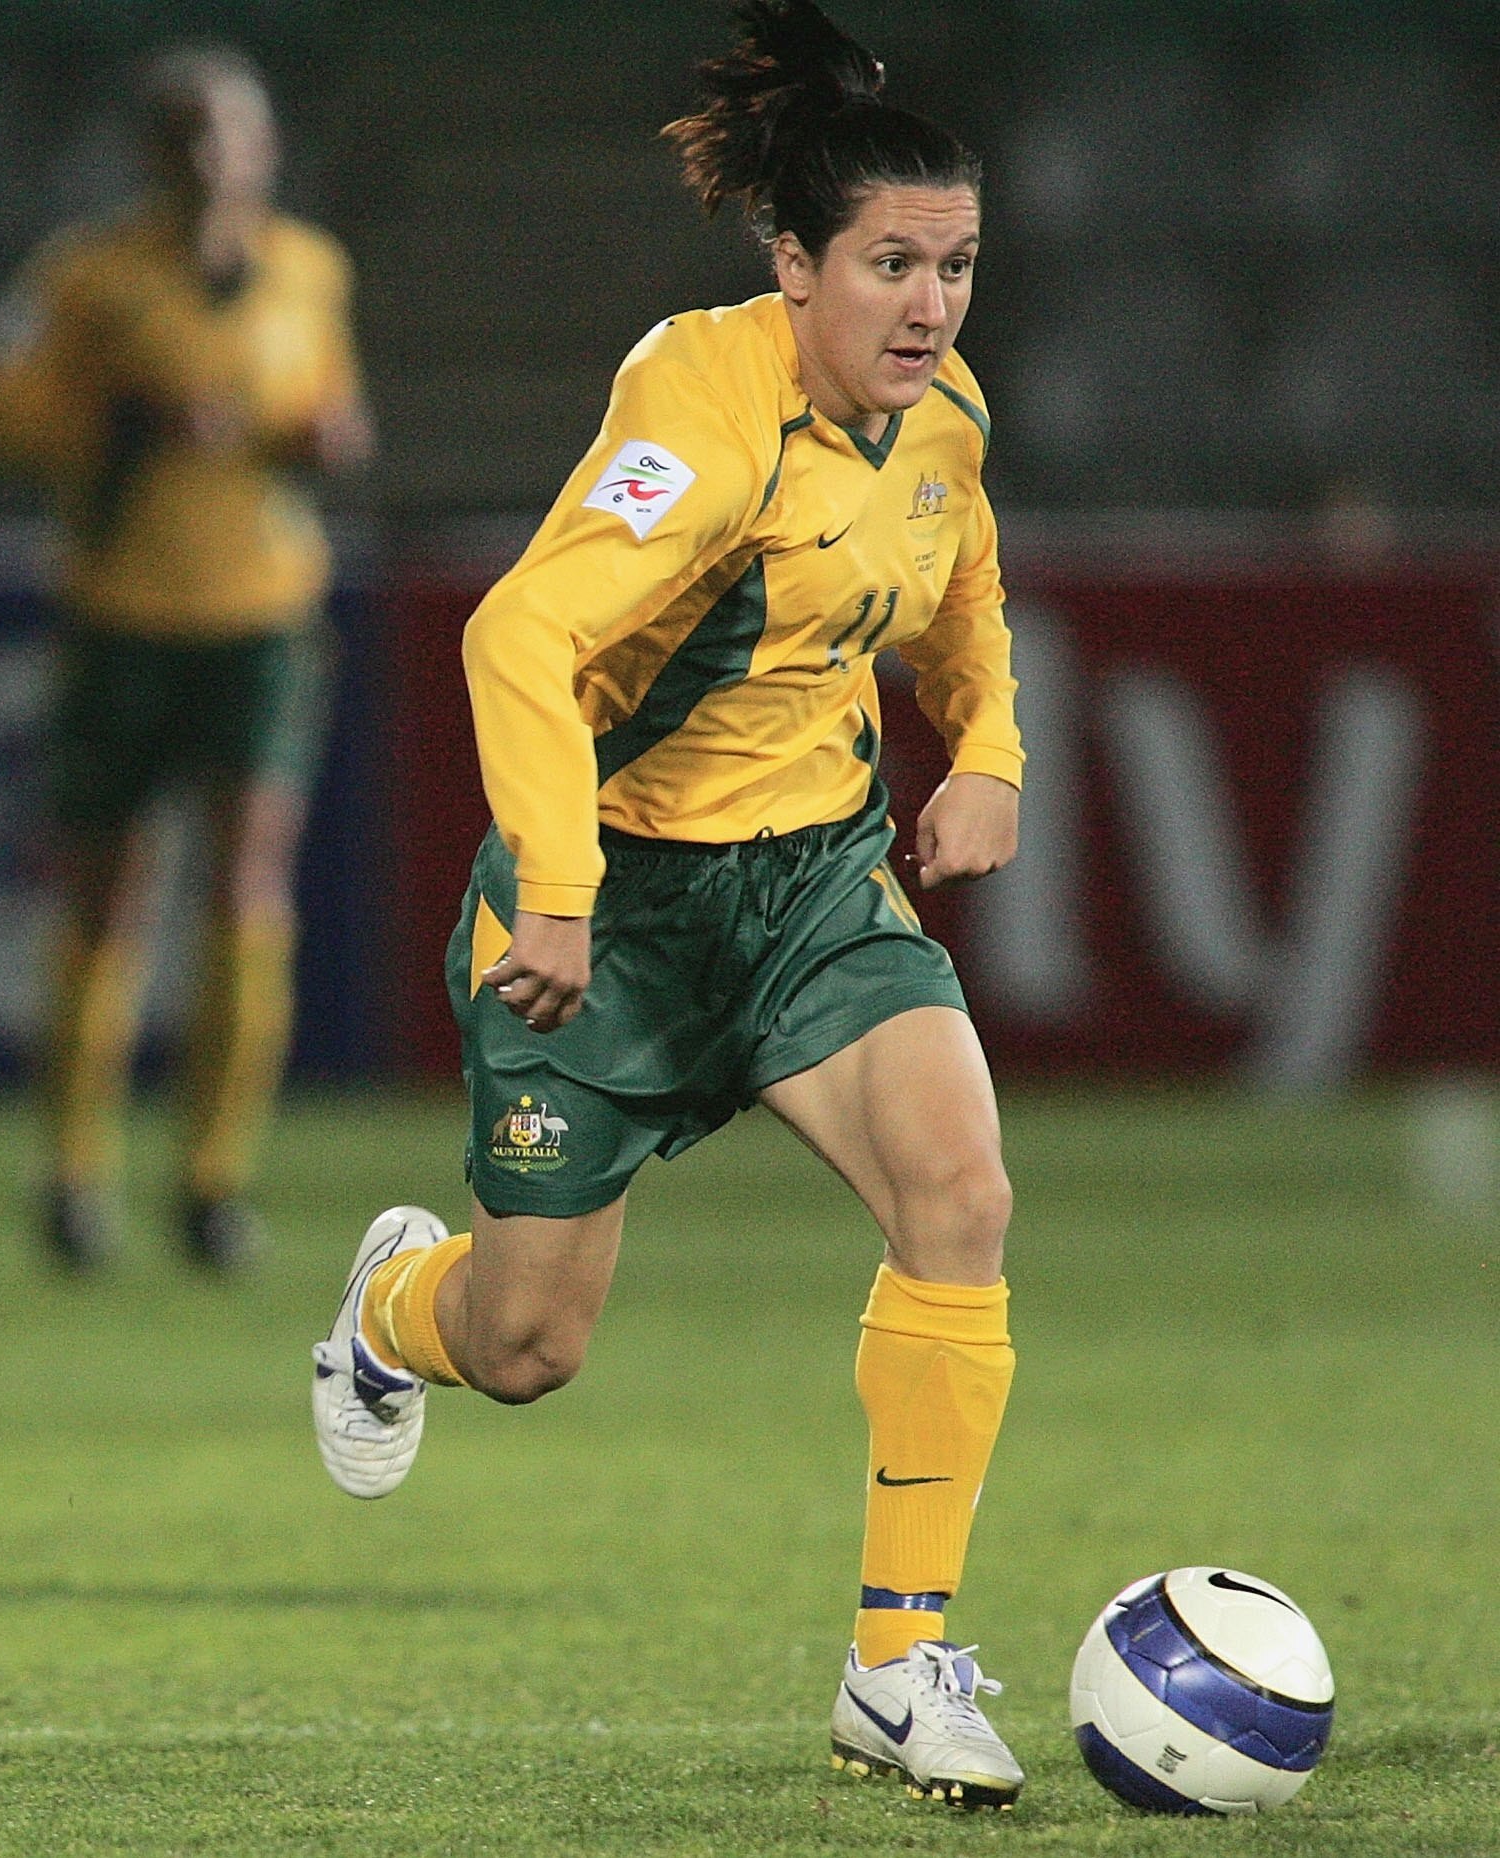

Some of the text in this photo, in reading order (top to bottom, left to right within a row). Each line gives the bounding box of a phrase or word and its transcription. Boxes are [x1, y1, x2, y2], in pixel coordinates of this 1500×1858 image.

[828, 586, 900, 665] 11
[900, 600, 1422, 1100] ly
[491, 1146, 559, 1157] AUSTRALIA
